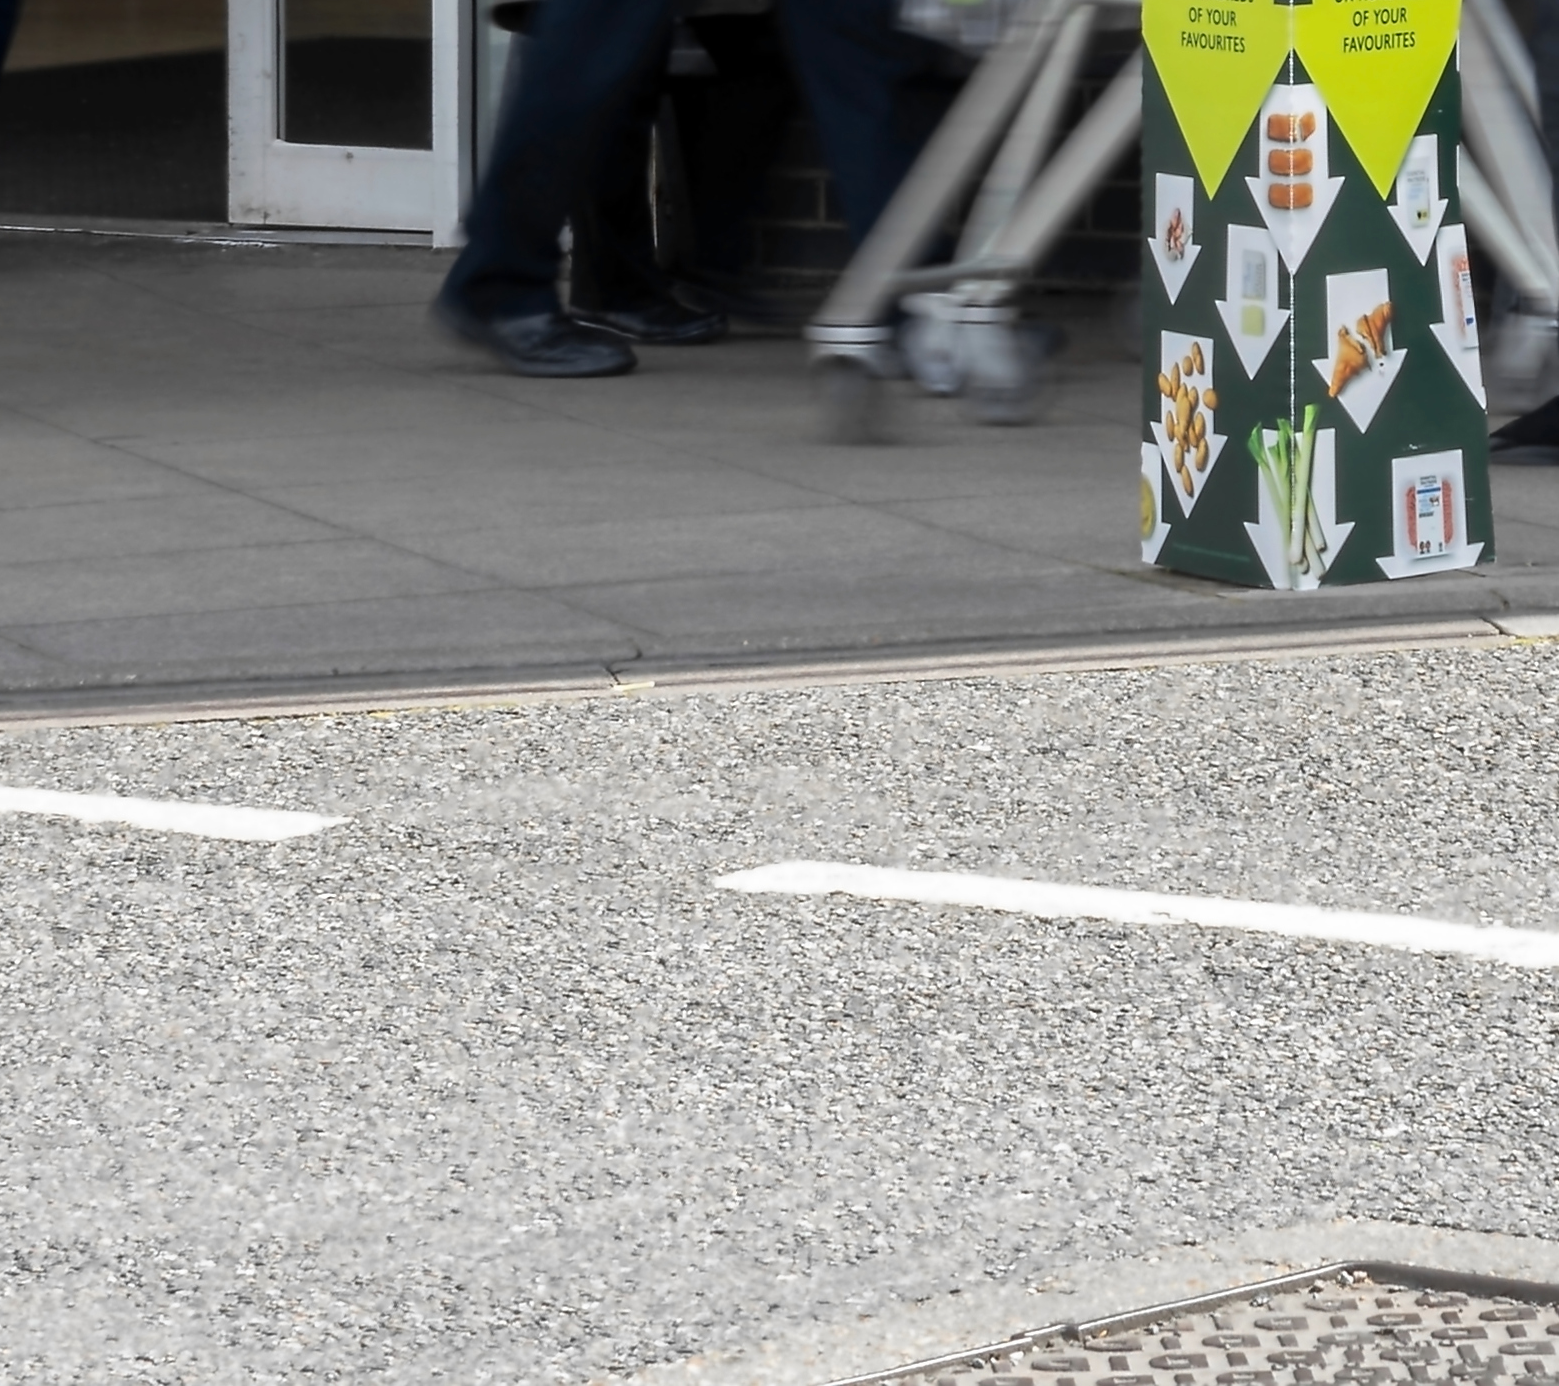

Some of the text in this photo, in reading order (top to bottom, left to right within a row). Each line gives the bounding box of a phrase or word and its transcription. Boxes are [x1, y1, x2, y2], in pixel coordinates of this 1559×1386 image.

[1189, 7, 1237, 27] OF YOUR
[1352, 7, 1408, 27] OF YOUR
[1181, 31, 1246, 53] FAVOURITES
[1343, 31, 1416, 53] FAVOURITES
